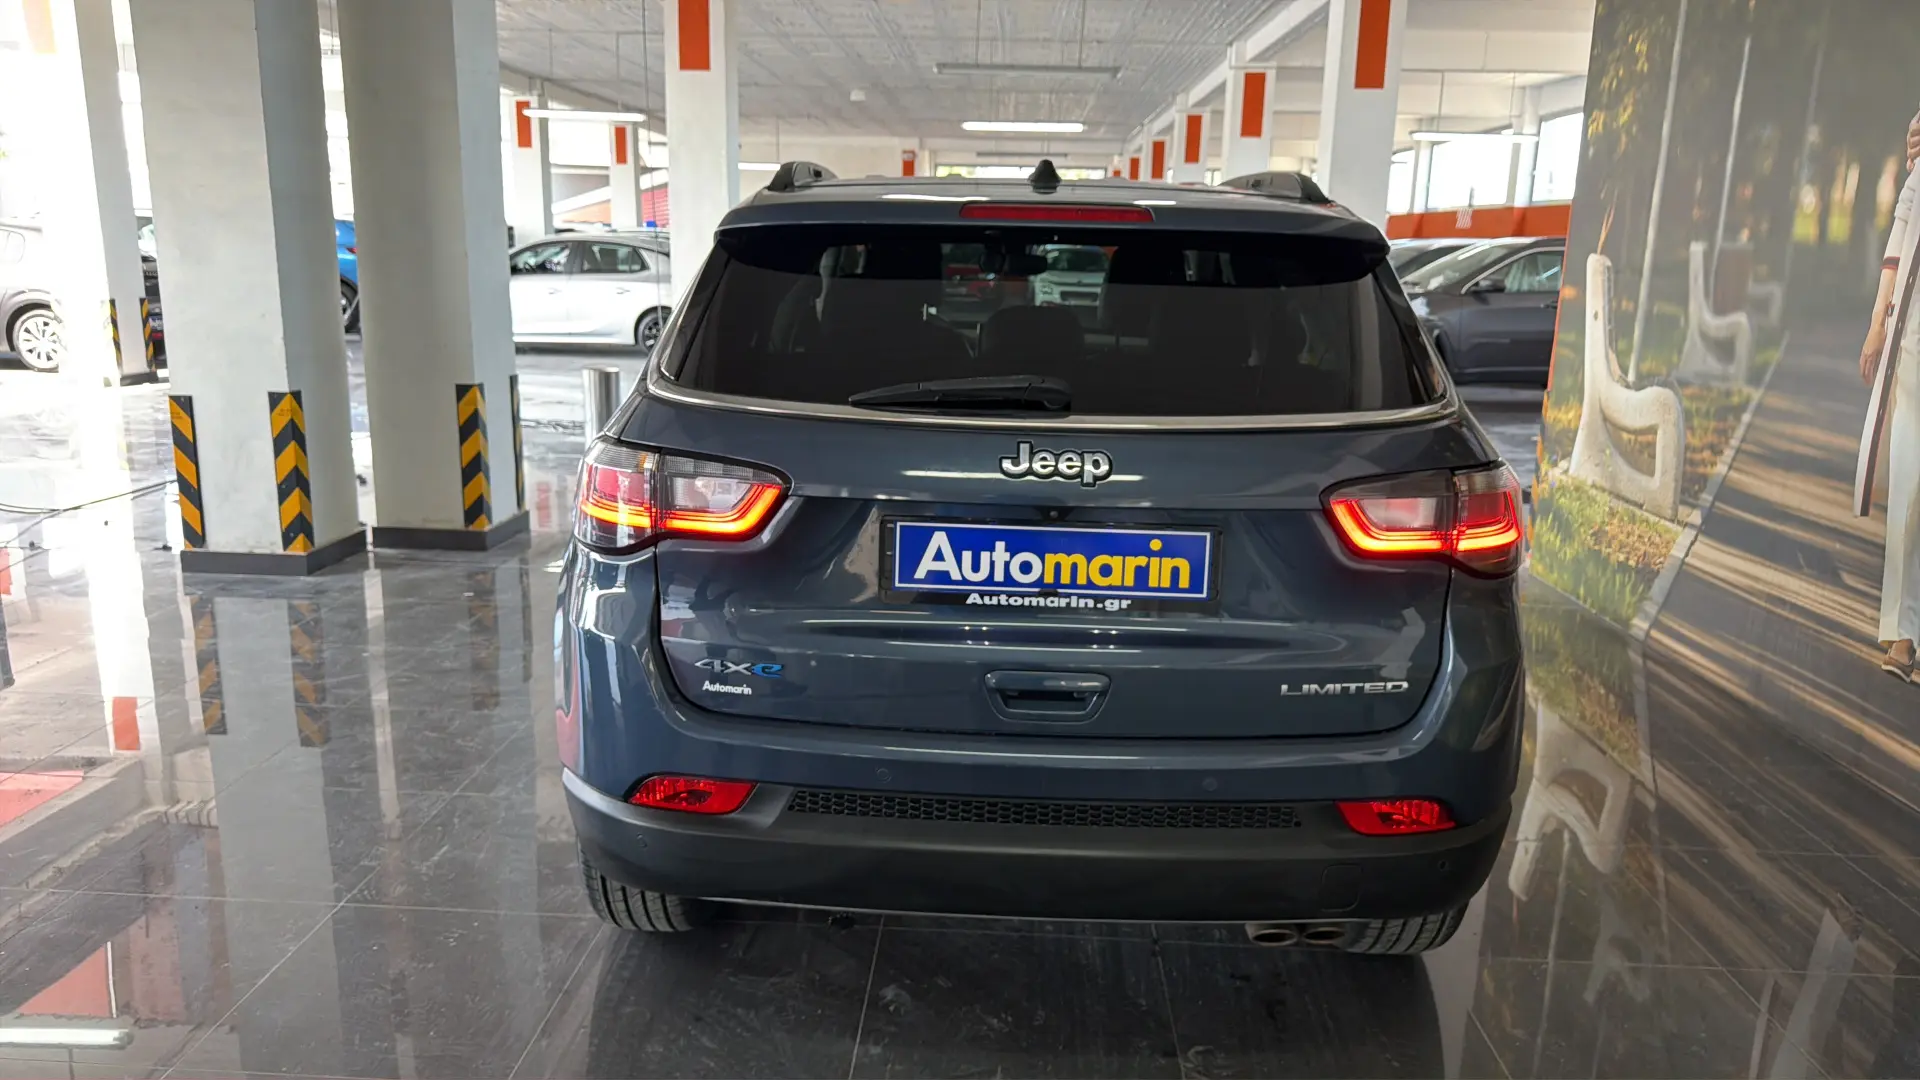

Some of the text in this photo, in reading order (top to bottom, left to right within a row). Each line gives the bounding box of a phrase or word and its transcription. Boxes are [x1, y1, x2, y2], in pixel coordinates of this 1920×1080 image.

[1000, 441, 1112, 486] Jeep
[913, 530, 1191, 588] Automarin
[965, 592, 1132, 611] Automarin.gr
[702, 680, 752, 695] Automarin
[1280, 681, 1409, 696] LIMITED
